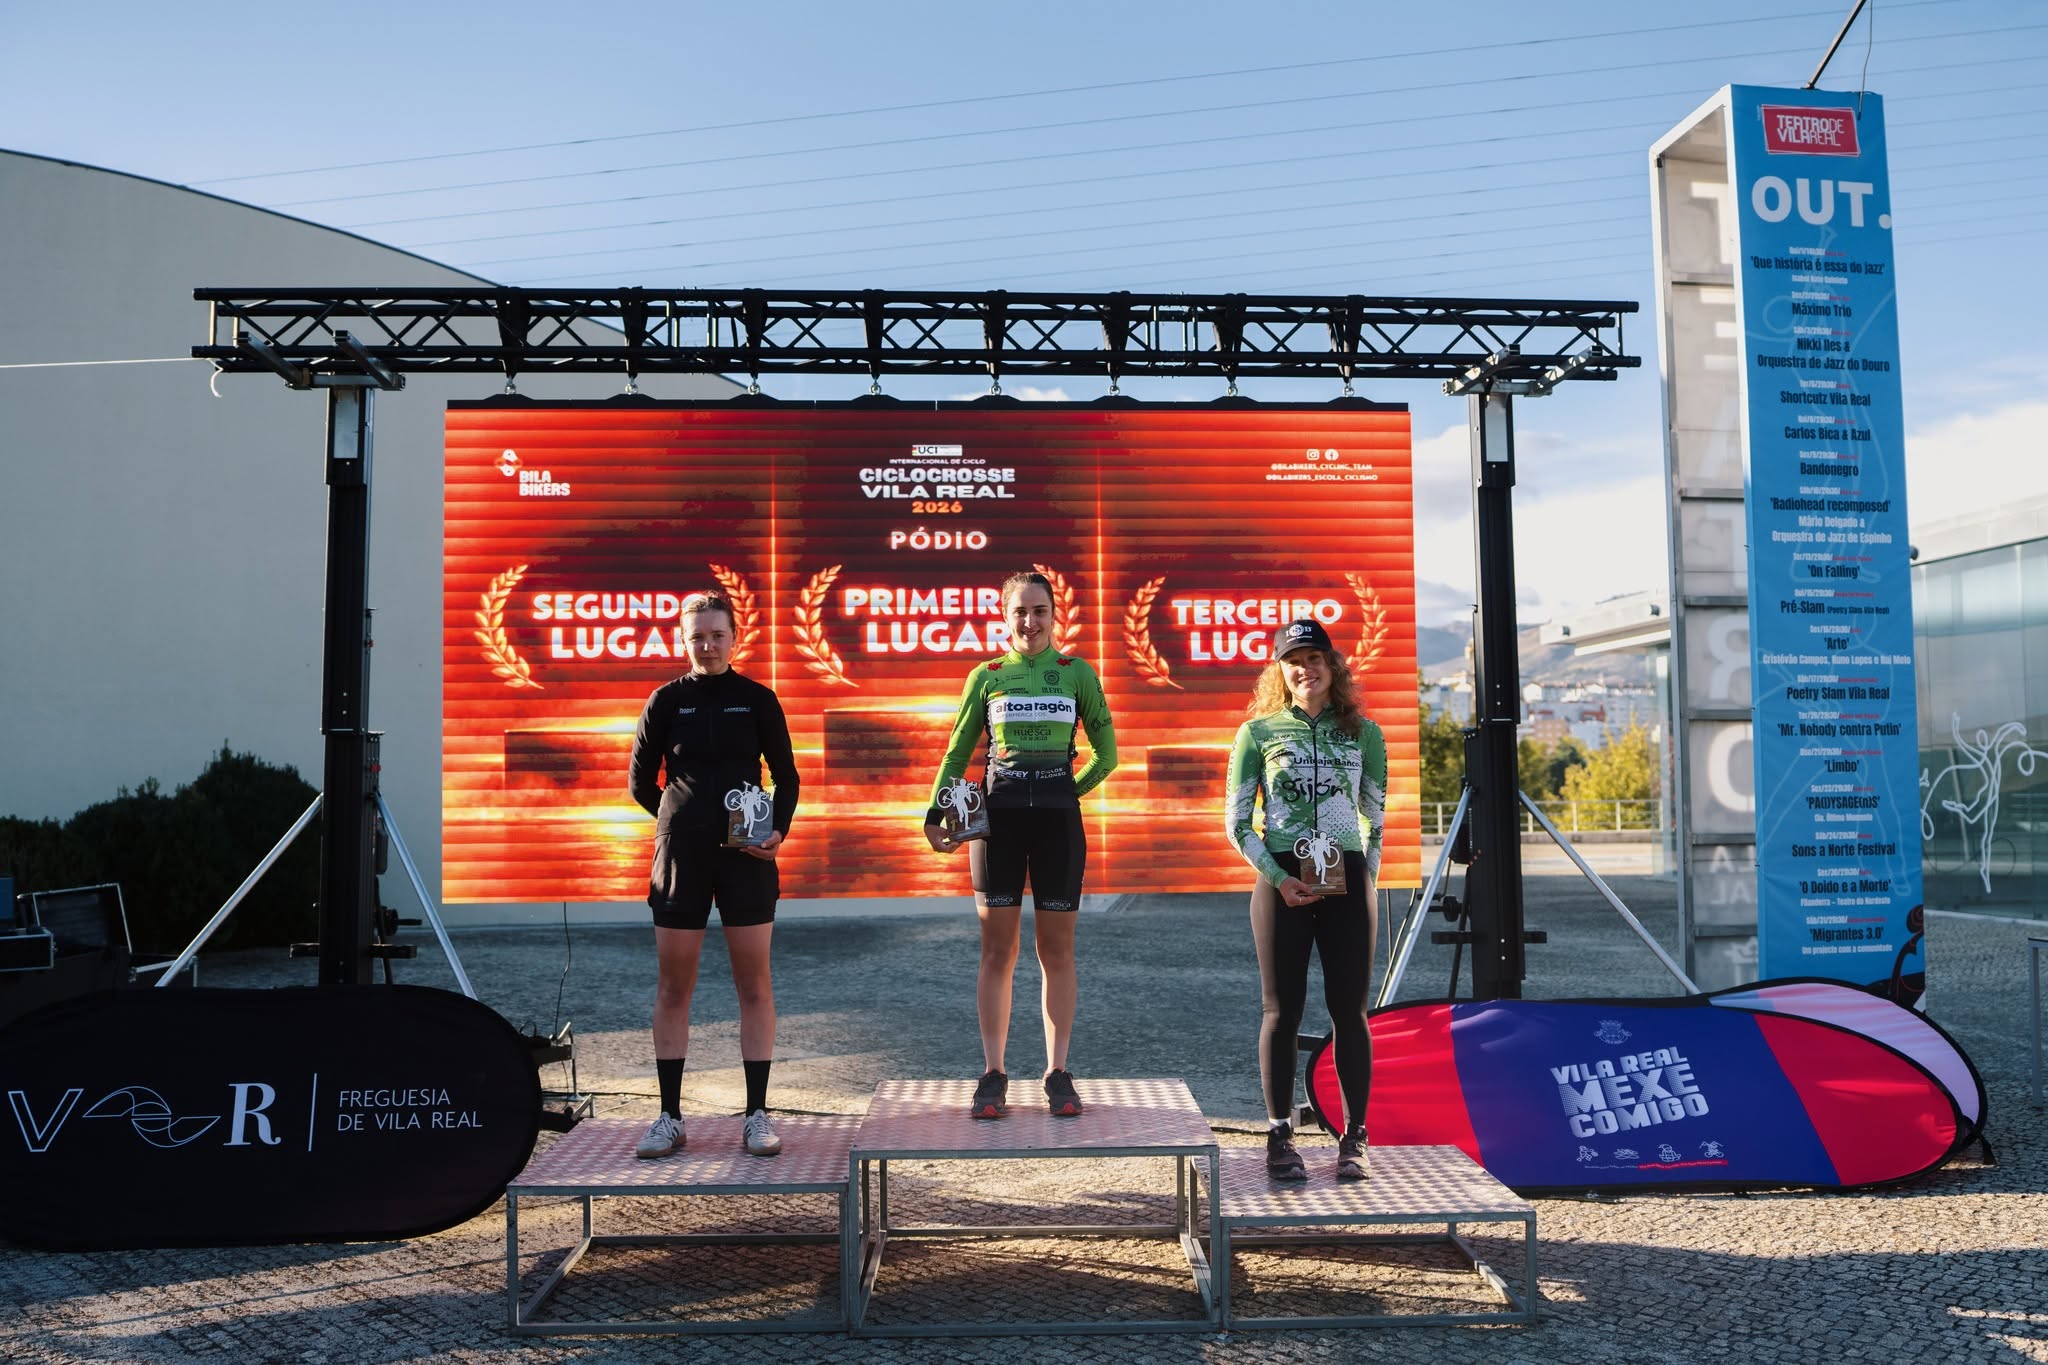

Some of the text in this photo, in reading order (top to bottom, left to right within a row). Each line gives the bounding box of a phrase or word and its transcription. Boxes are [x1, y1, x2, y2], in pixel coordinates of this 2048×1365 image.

[1751, 175, 1891, 229] OUT.
[1751, 256, 1885, 275] 'Que história é essa do jazz'
[1791, 302, 1852, 318] Máximo Trio
[1797, 338, 1822, 351] Nikki
[1844, 341, 1850, 352] &
[1757, 354, 1890, 372] Orquestra de Jazz do Douro
[1780, 390, 1871, 406] Shortcutz Vila Real
[1784, 426, 1871, 441] Carlos Bica & Azul
[917, 445, 939, 455] UCI
[519, 470, 552, 483] BILA
[859, 467, 1016, 483] CICLOCROSSE
[1800, 462, 1859, 477] Bandonegro
[519, 482, 571, 496] BIKERS
[861, 485, 1015, 498] VILA REAL
[911, 500, 963, 513] 2026
[1770, 497, 1891, 514] 'Radiohead recomposed'
[1798, 515, 1823, 527] Mário
[1824, 516, 1858, 529] Delgado
[890, 526, 987, 549] PÓDIO
[1772, 530, 1892, 544] Orquestra de Jazz de Espinho
[1808, 564, 1860, 579] 'On Falling'
[845, 588, 1003, 615] PRIMEIR
[1781, 600, 1825, 614] Pré-Slam
[1171, 598, 1342, 624] TERCEIRO
[867, 621, 1013, 652] LUGAR
[1824, 637, 1850, 650] 'Arte'
[1190, 631, 1278, 661] LUG
[1762, 653, 1798, 664] Cristóvão
[1787, 686, 1890, 701] Poetry Slam Vila Real
[1777, 722, 1902, 738] 'Mr. Nobody contra Putin'
[1824, 759, 1860, 773] 'Limbo'
[1792, 842, 1896, 857] Sons a Norte Festival
[1811, 880, 1838, 893] Doido
[1842, 882, 1848, 892] e
[1851, 881, 1857, 892] a
[1859, 880, 1892, 892] Morte'
[1810, 926, 1884, 942] 'Migrantes 3.0'
[1550, 1046, 1688, 1085] VILA REAL
[1557, 1063, 1700, 1116] MEXE
[339, 1088, 451, 1108] FREGUESIA
[337, 1111, 483, 1131] DE VILA REAL
[1569, 1093, 1710, 1138] COMIGO
